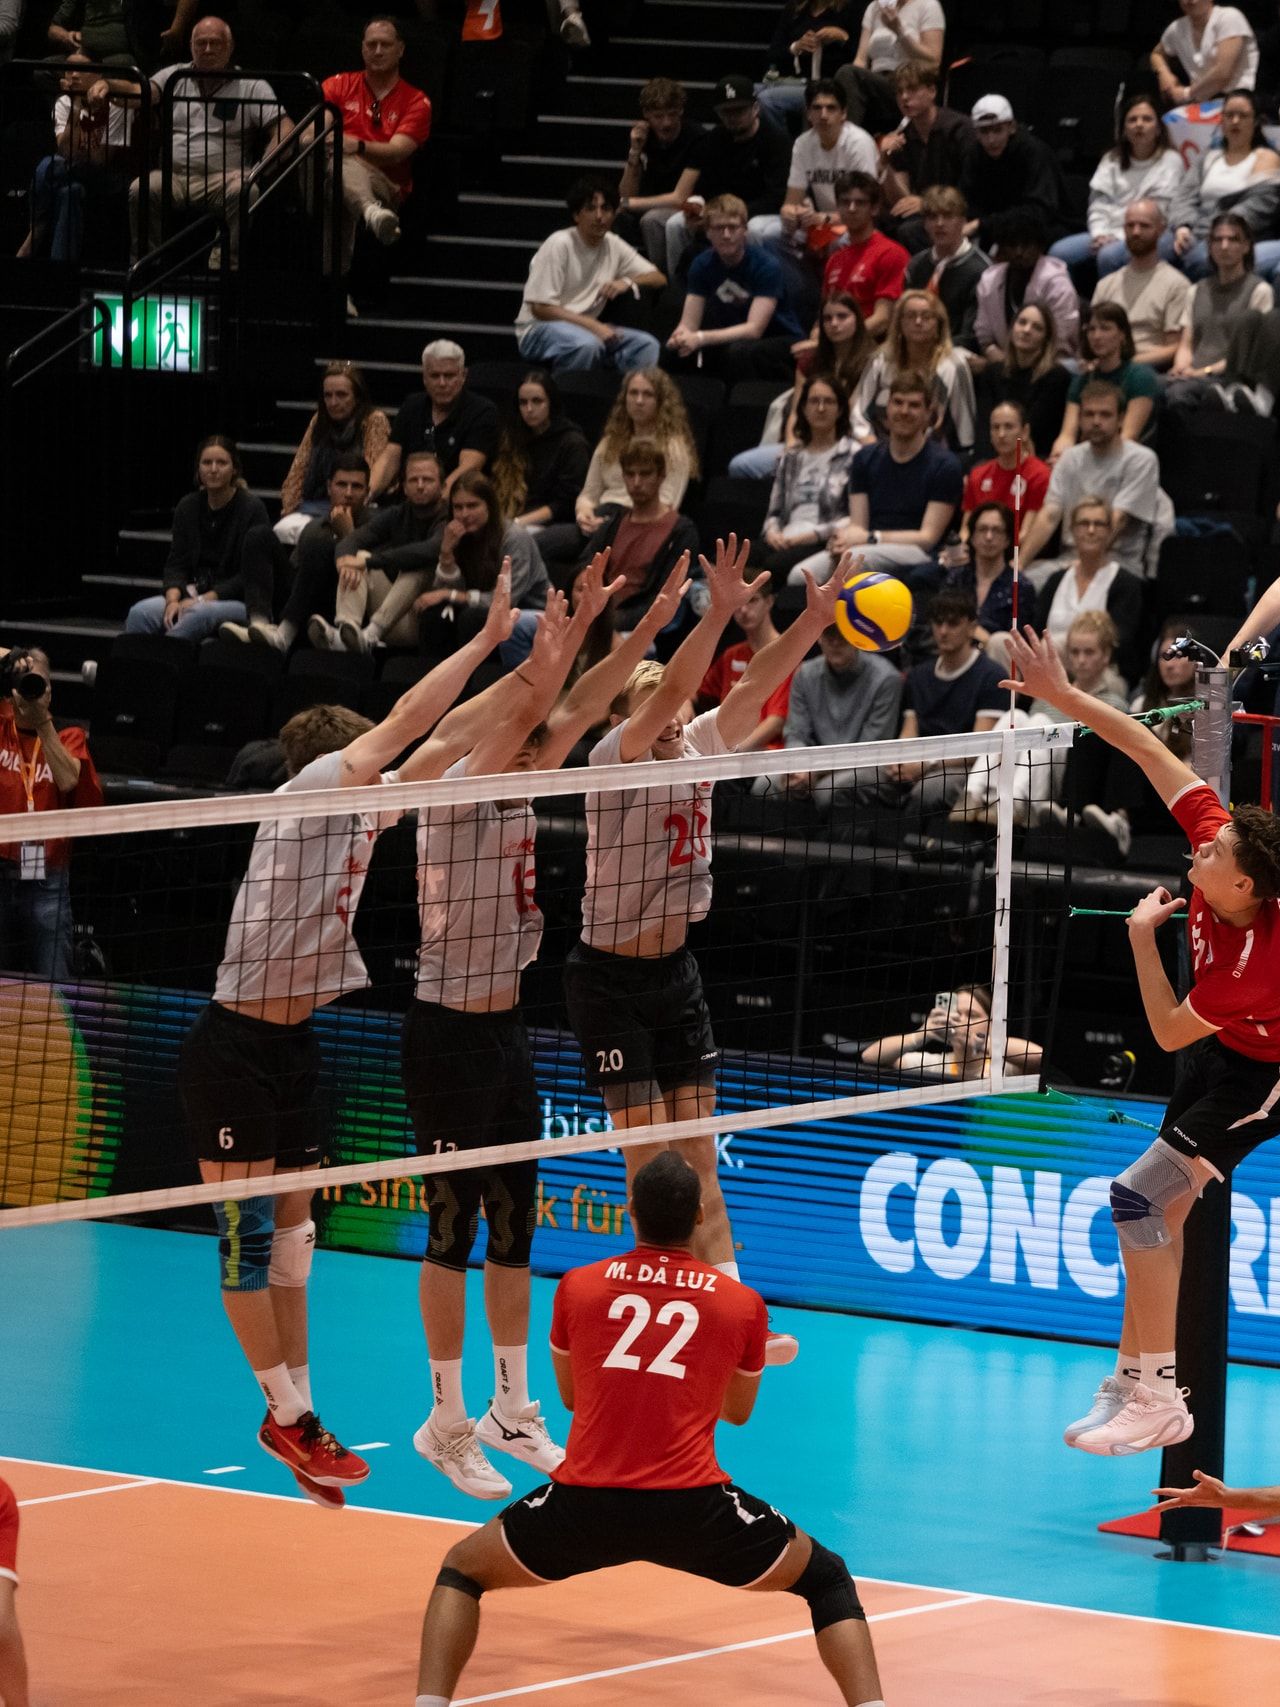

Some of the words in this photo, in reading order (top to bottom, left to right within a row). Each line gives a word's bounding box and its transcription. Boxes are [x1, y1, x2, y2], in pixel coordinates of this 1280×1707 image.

[596, 1048, 624, 1073] 20
[218, 1126, 235, 1150] 6
[604, 1261, 633, 1280] M.
[637, 1263, 667, 1285] DA
[675, 1269, 718, 1293] LUZ
[601, 1293, 700, 1380] 22
[499, 1357, 509, 1384] CRAFT
